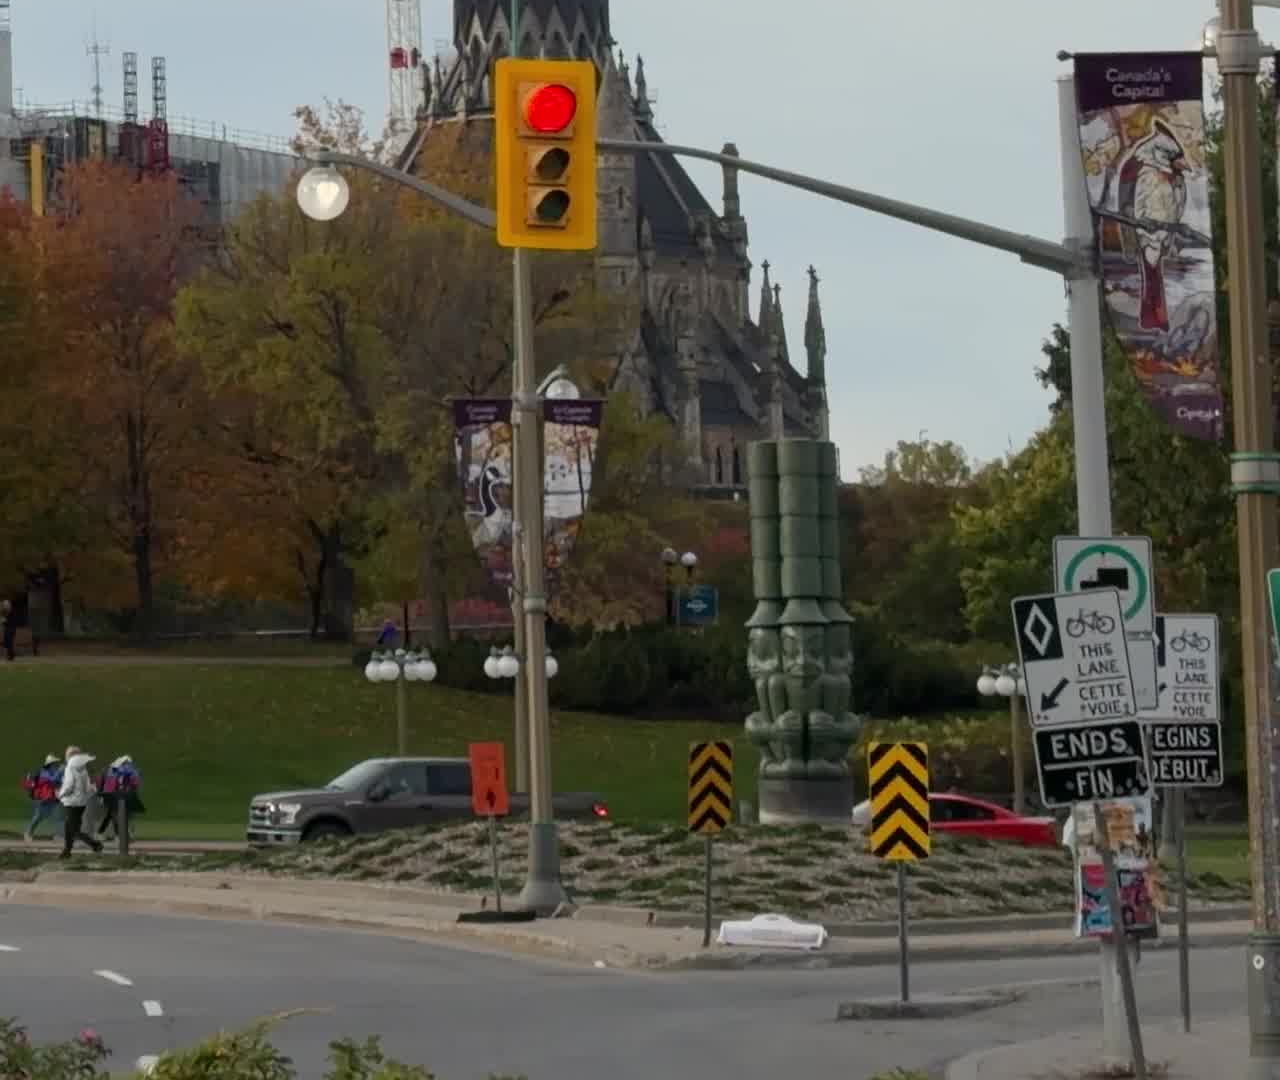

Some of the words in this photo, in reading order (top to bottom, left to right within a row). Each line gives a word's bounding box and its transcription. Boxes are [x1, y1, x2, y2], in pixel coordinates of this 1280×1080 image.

[1111, 83, 1165, 100] Capital
[1079, 642, 1114, 659] THIS
[1077, 659, 1120, 677] LANE
[1178, 658, 1206, 671] THIS
[1174, 672, 1209, 685] LANE
[1078, 682, 1127, 701] CETTE
[1173, 691, 1211, 704] CETTE
[1088, 700, 1122, 716] VOIE
[1178, 705, 1206, 717] VOIE
[1050, 727, 1128, 760] ENDS
[1152, 726, 1211, 748] EGINS
[1075, 767, 1115, 797] FIN
